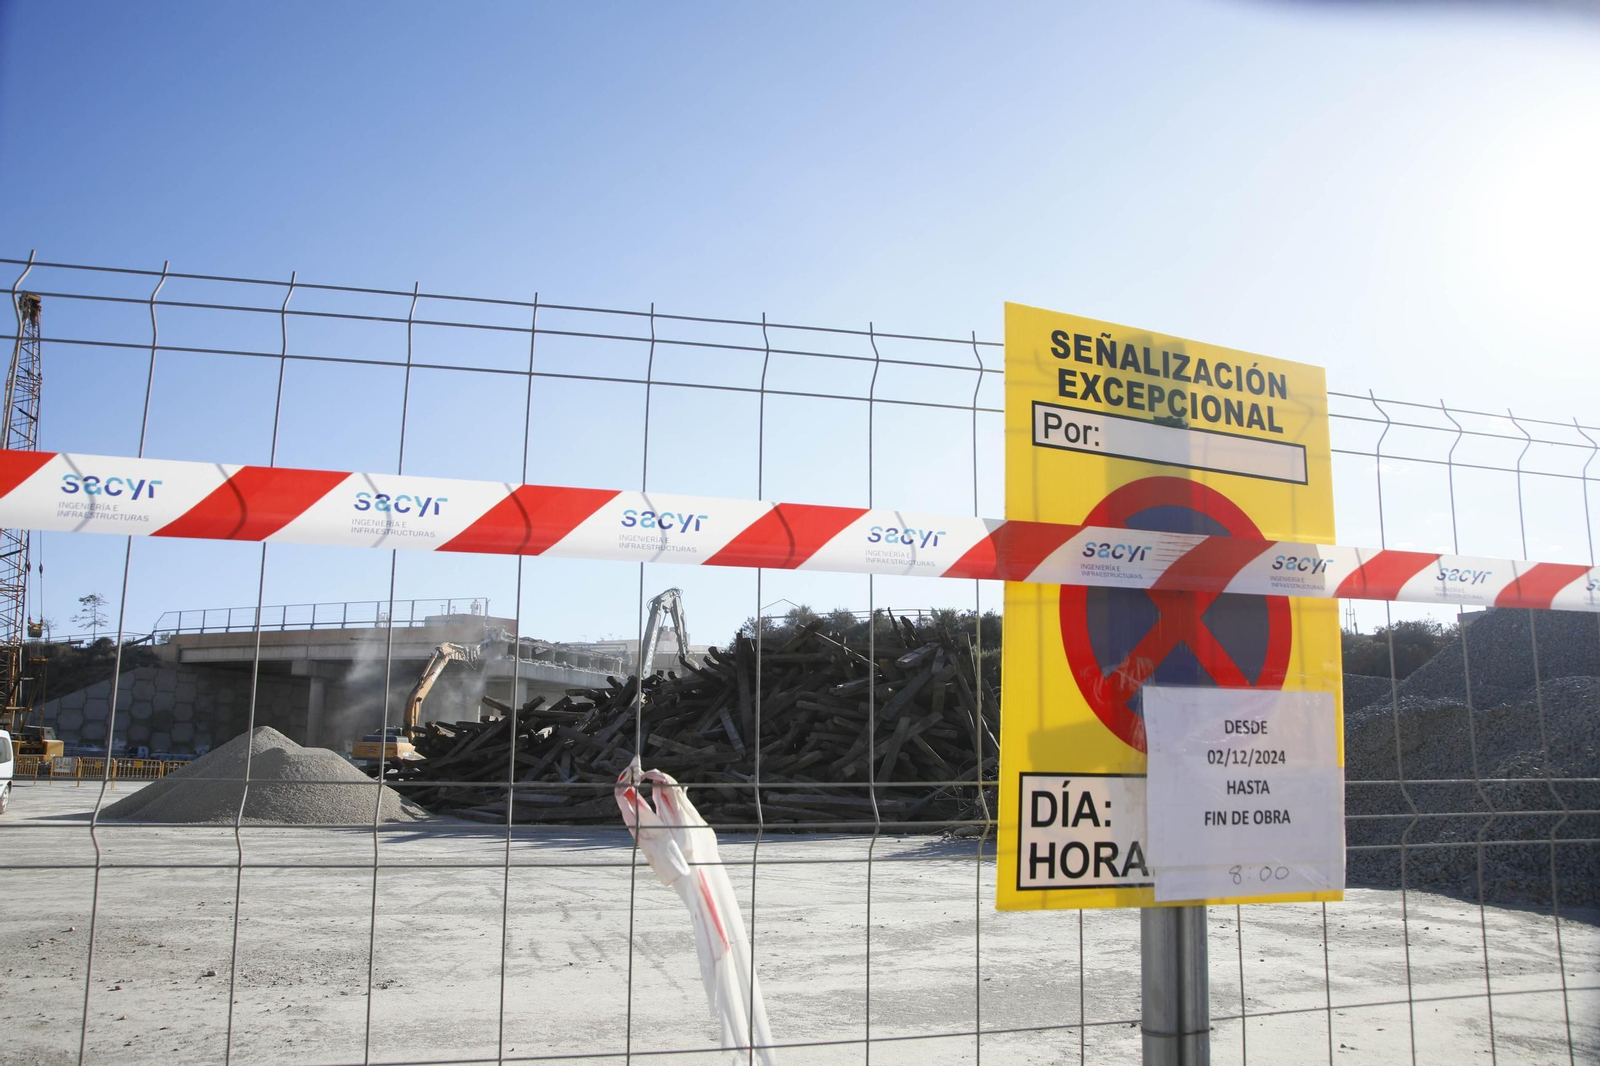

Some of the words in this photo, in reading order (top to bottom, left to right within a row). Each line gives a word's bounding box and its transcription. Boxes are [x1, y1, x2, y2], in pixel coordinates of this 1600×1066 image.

[1050, 329, 1288, 400] SEÑALIZACIÓN
[1058, 368, 1284, 434] EXCEPCIONAL
[1043, 411, 1100, 447] Por:
[61, 474, 162, 500] sacyr
[58, 502, 111, 511] INGENIERÍA
[354, 491, 448, 517] sacyr
[57, 510, 150, 522] INFRAESTRUCTURAS
[351, 518, 400, 527] INGENIERÍA
[621, 509, 708, 533] sacyr
[351, 527, 436, 538] INFRAESTRUCTURAS
[619, 534, 663, 543] INGENIERÍA
[867, 526, 946, 548] sacyr
[619, 542, 697, 553] INFRAESTRUCTURAS
[1082, 542, 1152, 562] sacyr
[865, 557, 935, 567] INFRAESTRUCTURAS
[1272, 555, 1334, 574] sacyr
[1437, 568, 1492, 585] sacyr
[1224, 720, 1268, 734] DESDE
[1207, 748, 1286, 767] 02/12/2024
[1226, 780, 1270, 795] HASTA
[1030, 780, 1112, 828] DÍA:
[1204, 811, 1227, 826] FIN
[1231, 811, 1249, 825] DE
[1253, 810, 1291, 825] OBRA
[1029, 840, 1155, 879] HORA
[1228, 865, 1290, 885] 8:00
